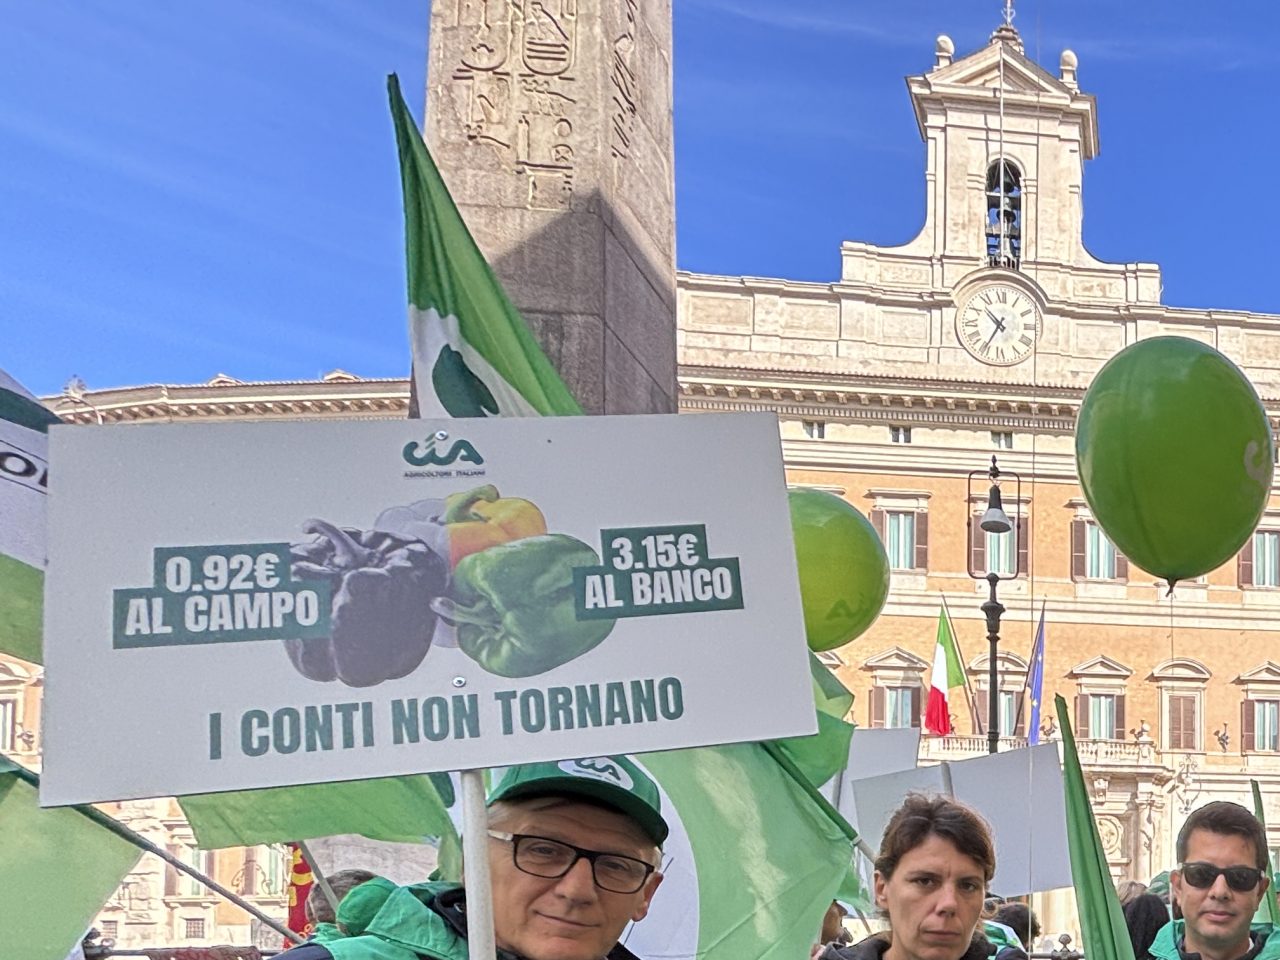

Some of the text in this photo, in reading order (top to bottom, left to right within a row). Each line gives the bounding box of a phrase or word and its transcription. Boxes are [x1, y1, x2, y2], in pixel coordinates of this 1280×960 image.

[611, 533, 700, 570] 3.15€
[165, 553, 280, 593] 0.92€
[585, 567, 733, 609] AL BANCO
[125, 590, 319, 636] AL CAMPO
[209, 676, 685, 760] I CONTI NON TORNANO
